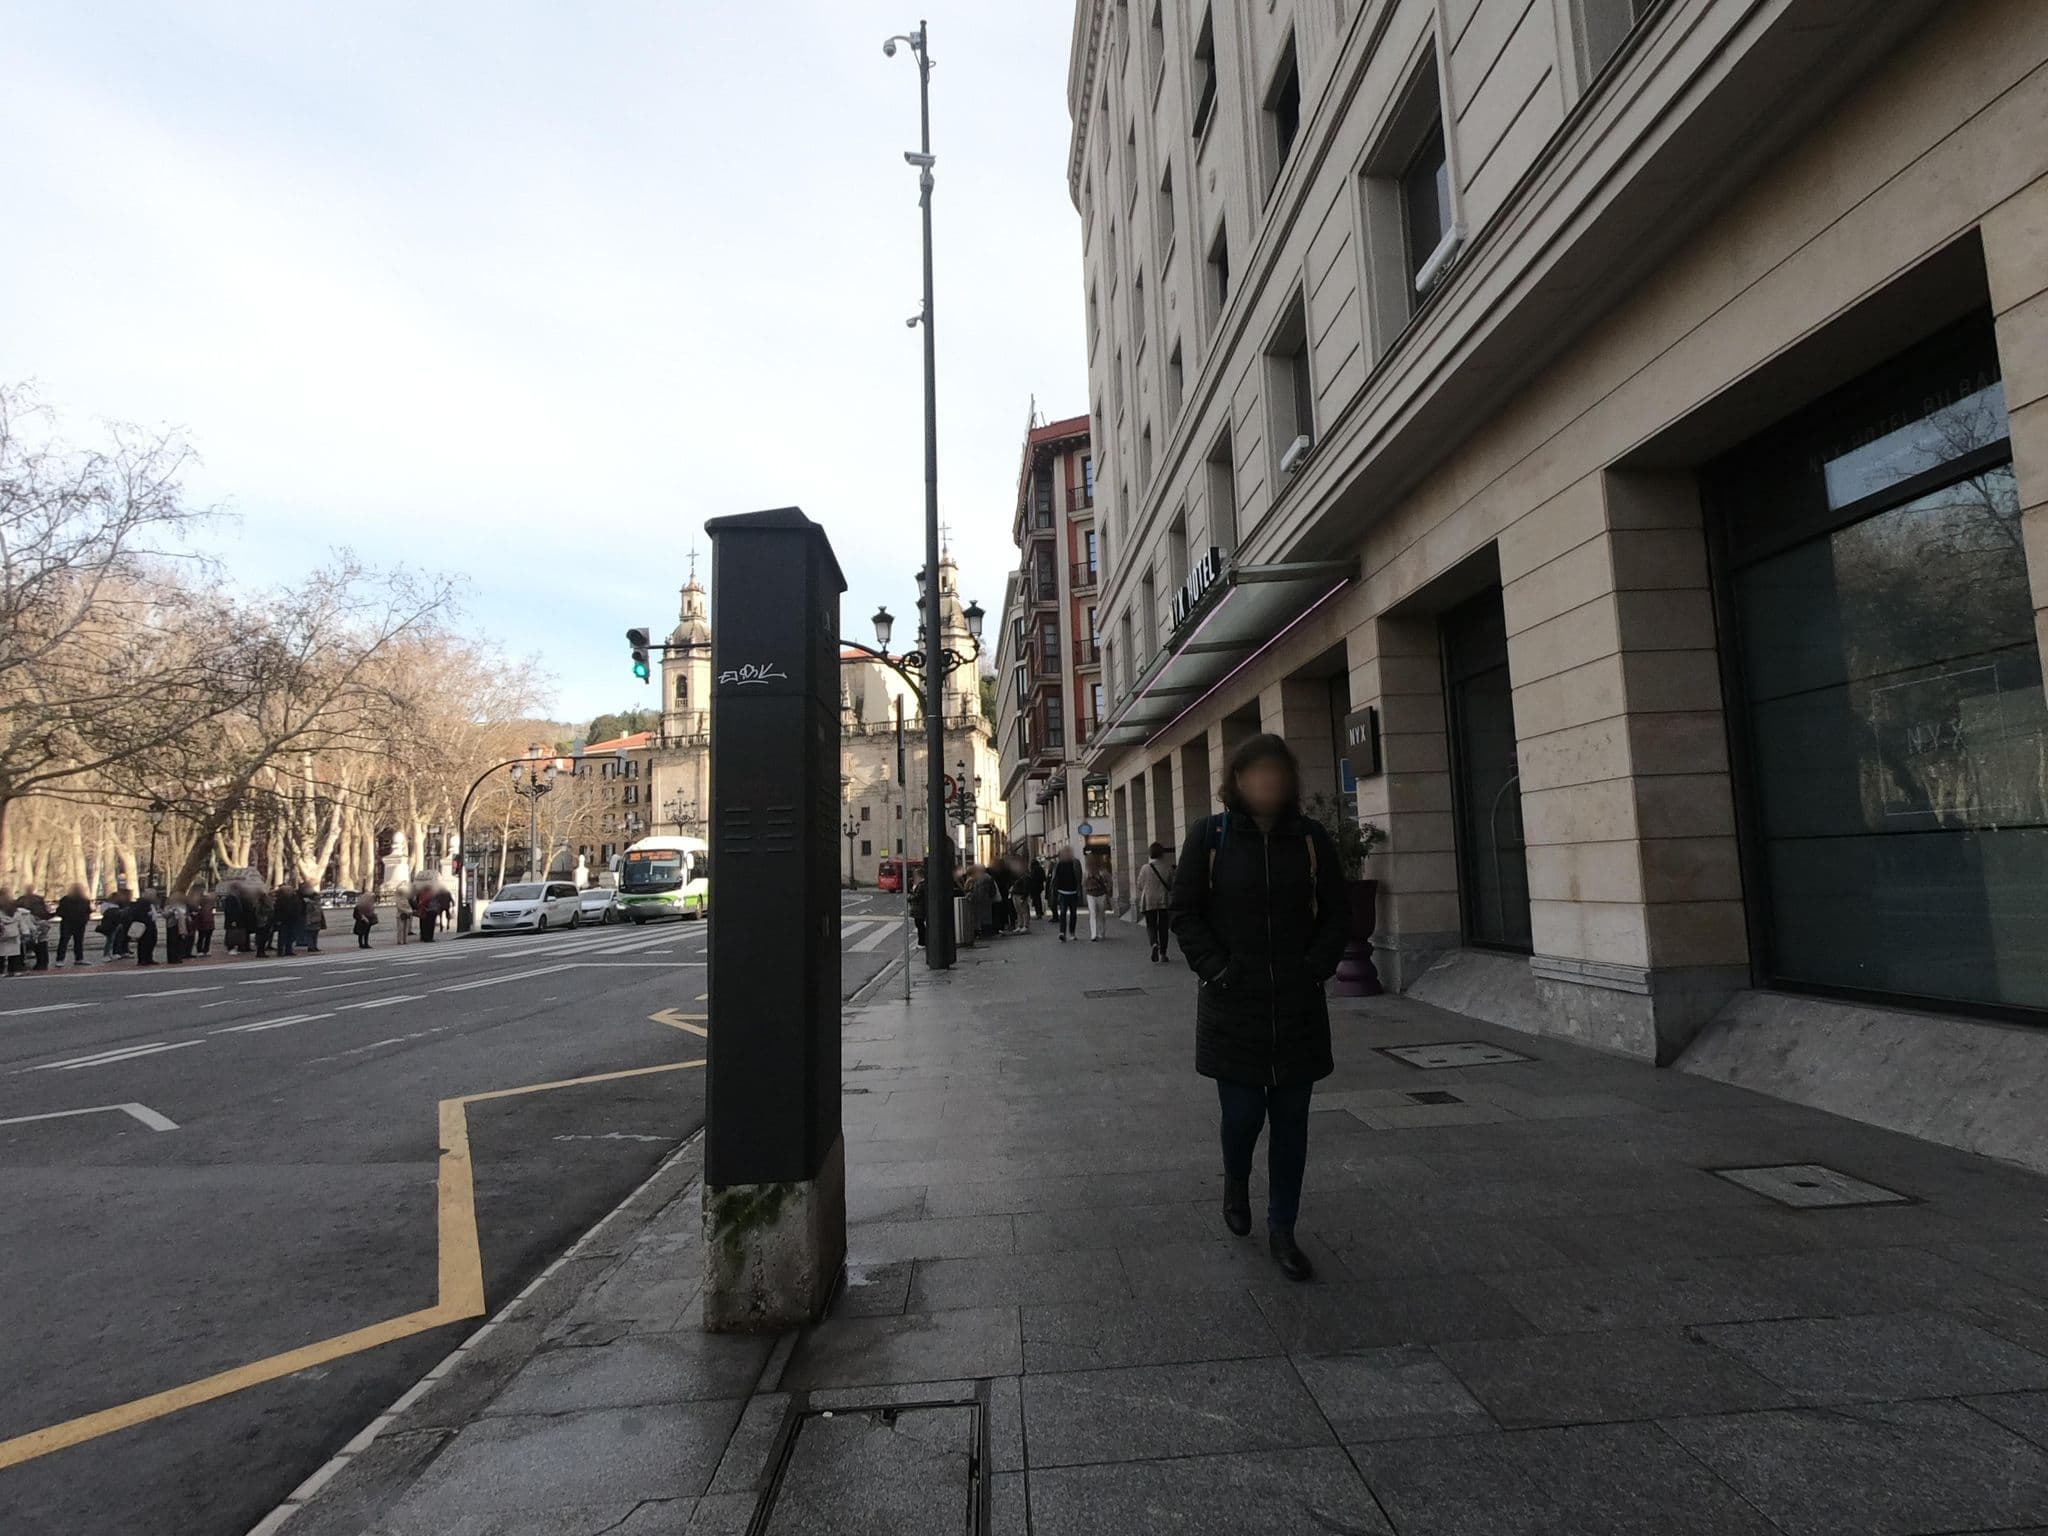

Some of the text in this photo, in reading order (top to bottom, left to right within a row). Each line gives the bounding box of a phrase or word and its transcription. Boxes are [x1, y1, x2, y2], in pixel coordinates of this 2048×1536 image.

[1849, 407, 1910, 448] HOTEL
[1186, 547, 1215, 609] HOTEL
[1349, 723, 1367, 747] NYX
[1907, 719, 1968, 755] NYX
